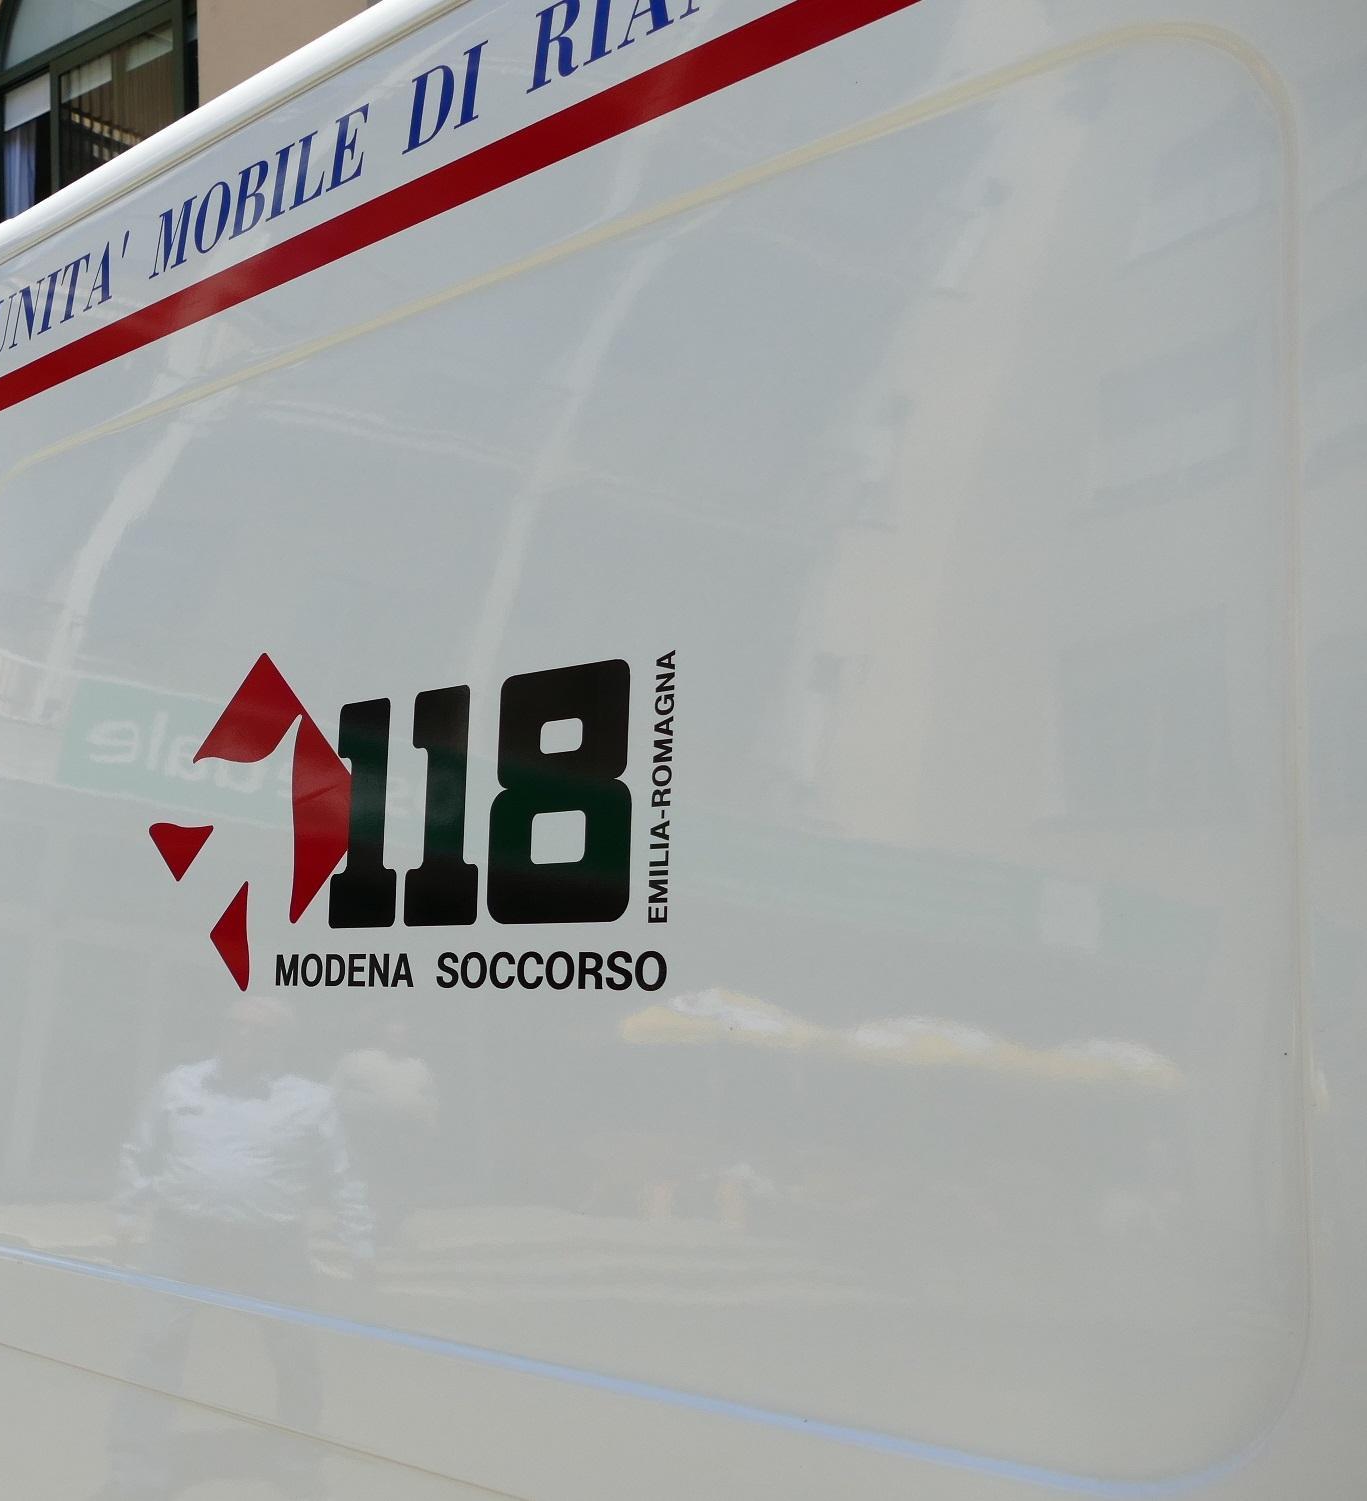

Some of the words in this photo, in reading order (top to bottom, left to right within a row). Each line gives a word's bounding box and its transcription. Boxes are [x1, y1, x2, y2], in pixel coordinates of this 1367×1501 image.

[147, 104, 369, 280] MOBILE
[401, 39, 489, 154] DI
[525, 0, 700, 94] RIA
[328, 658, 633, 929] 118
[647, 649, 677, 925] EMILIA-ROMAGNA
[274, 953, 415, 988] MODENA
[435, 950, 669, 992] SOCCORSO
